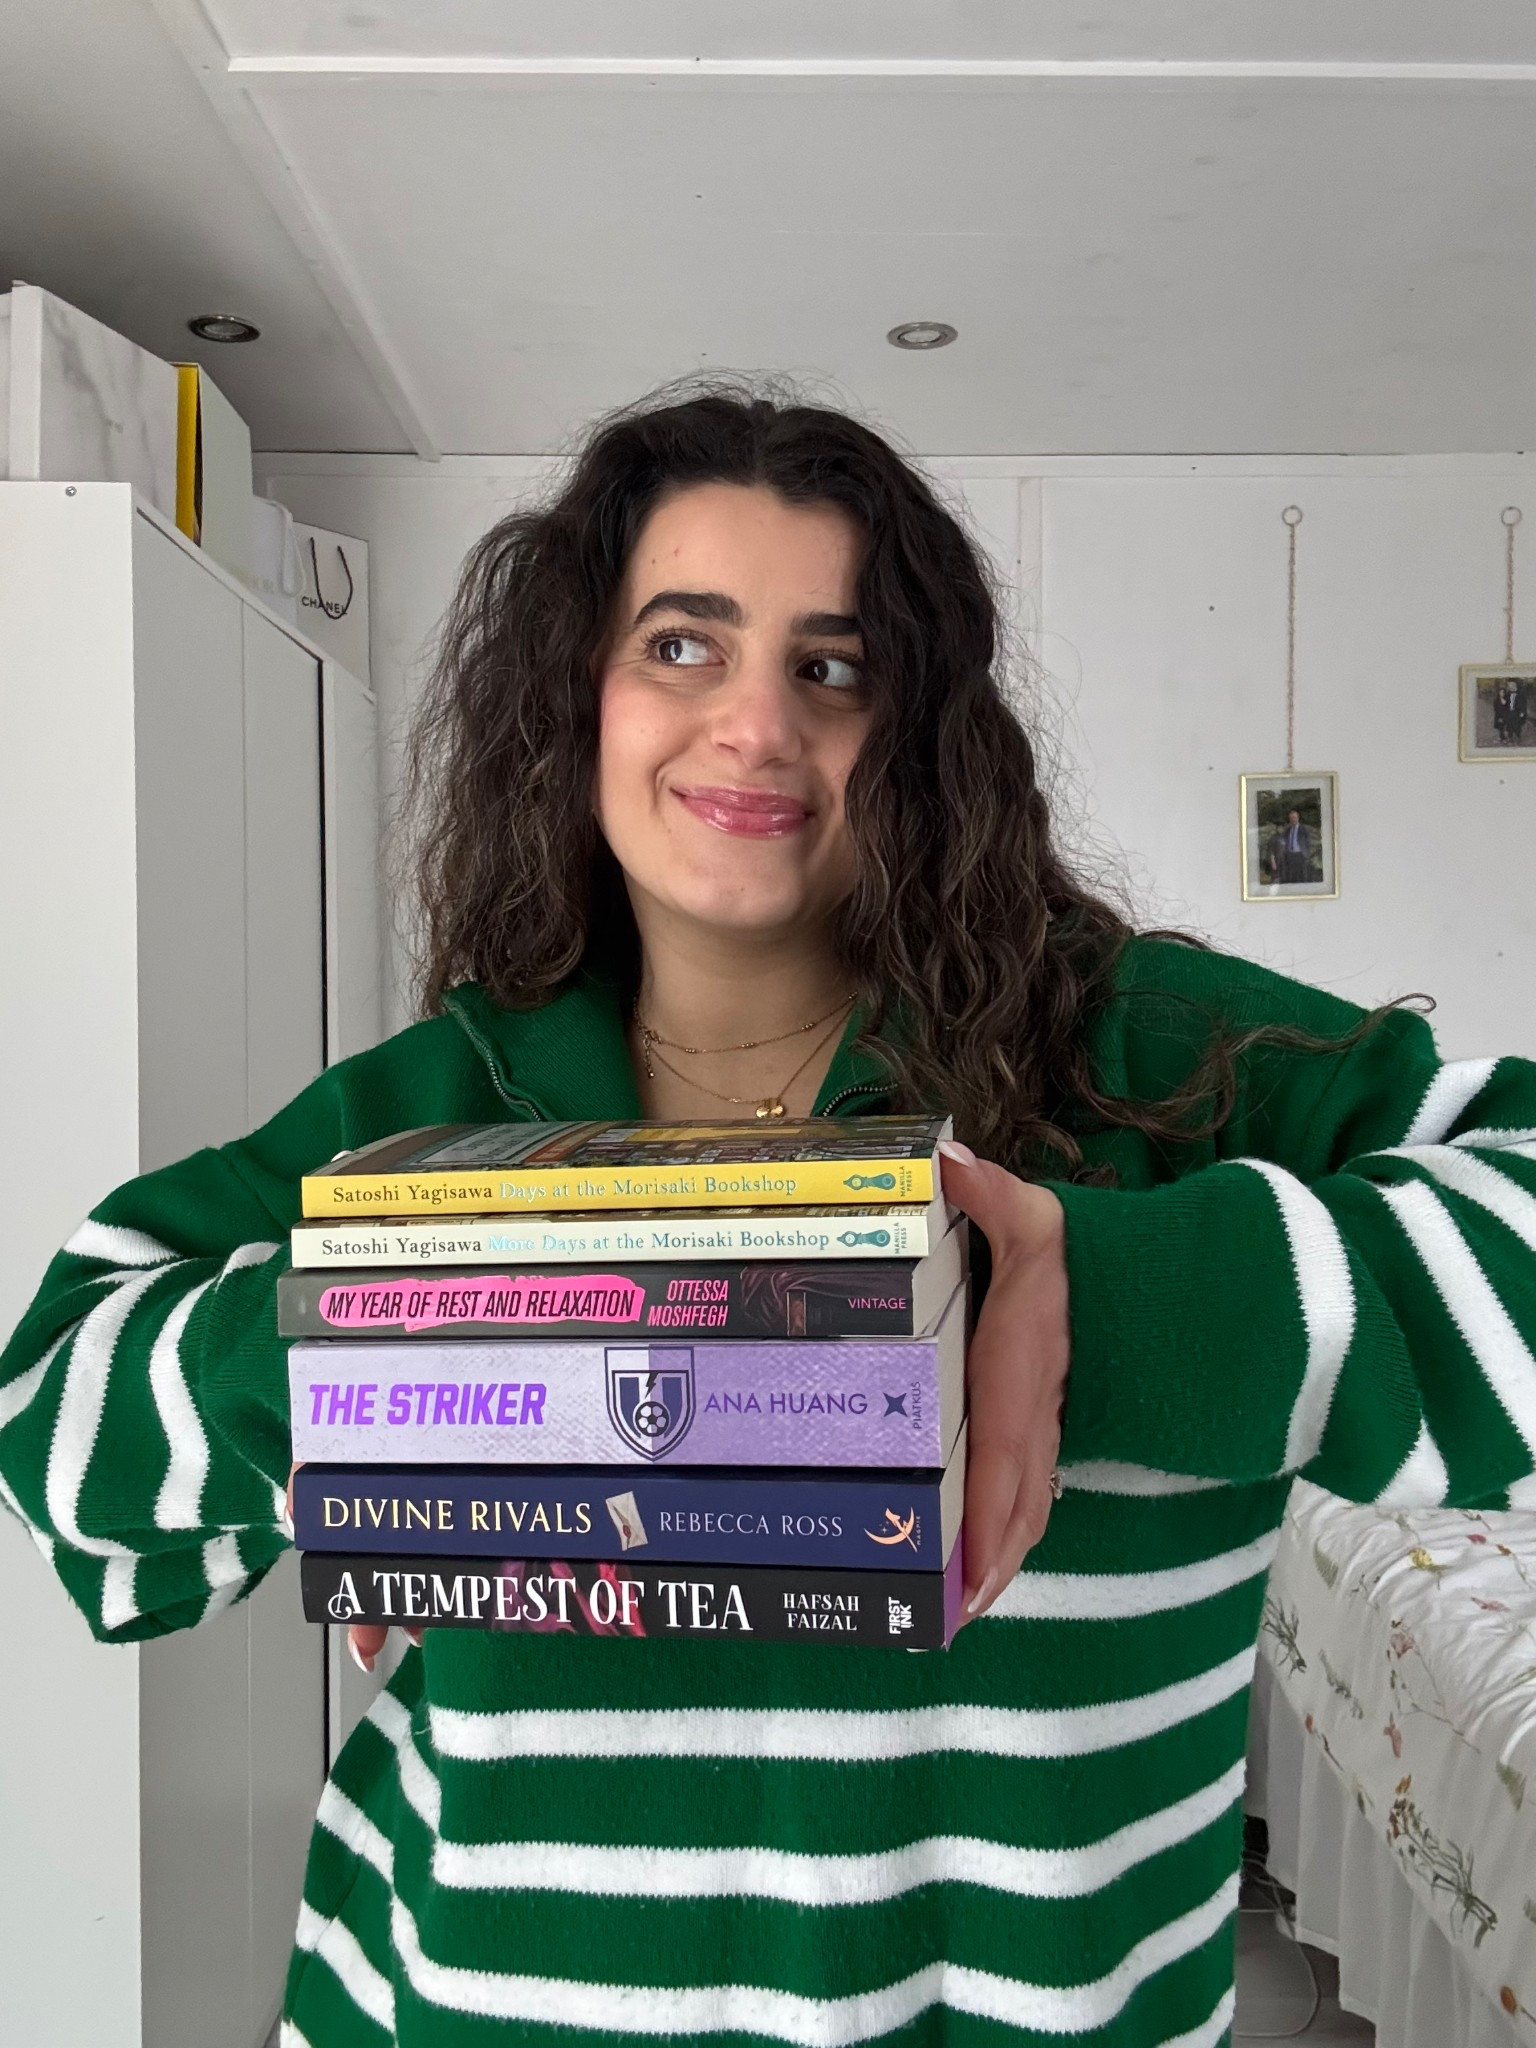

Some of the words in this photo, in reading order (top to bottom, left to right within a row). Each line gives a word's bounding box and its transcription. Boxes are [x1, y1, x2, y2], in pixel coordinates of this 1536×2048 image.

[301, 596, 347, 615] CHANEL
[333, 1185, 399, 1203] Satoshi
[407, 1183, 493, 1205] Yagisawa
[500, 1182, 547, 1203] Days
[553, 1182, 570, 1197] at
[578, 1179, 606, 1197] the
[613, 1176, 697, 1196] Morisaki
[705, 1175, 798, 1196] Bookshop
[322, 1238, 388, 1256] Satoshi
[396, 1237, 482, 1258] Yagisawa
[488, 1235, 535, 1252] More
[543, 1235, 586, 1254] Days
[593, 1236, 609, 1250] at
[616, 1233, 644, 1249] the
[651, 1231, 733, 1249] Morisaki
[741, 1229, 830, 1251] Bookshop
[667, 1280, 729, 1302] OTTESSA
[326, 1292, 357, 1319] MY
[360, 1292, 402, 1319] YEAR
[407, 1291, 434, 1319] OF
[436, 1291, 483, 1318] REST
[483, 1290, 522, 1318] AND
[525, 1289, 636, 1318] RELAXATION
[647, 1305, 729, 1327] MOSHFEGH
[848, 1298, 907, 1310] VINTAGE
[309, 1384, 378, 1425] THE
[387, 1383, 547, 1425] STRIKER
[704, 1392, 762, 1415] ANA
[770, 1392, 868, 1415] HUANG
[912, 1381, 922, 1430] PIATKUS
[322, 1497, 454, 1531] DIVINE
[470, 1500, 592, 1534] RIVALS
[660, 1511, 770, 1535] REBECCA
[782, 1514, 843, 1537] ROSS
[328, 1571, 365, 1620] A
[373, 1570, 577, 1623] TEMPEST
[589, 1579, 645, 1626] OF
[658, 1579, 754, 1631] TEA
[783, 1593, 860, 1611] HAFSAH
[787, 1613, 858, 1631] FAIZAL
[888, 1596, 901, 1634] FIRST
[900, 1604, 913, 1629] INK
